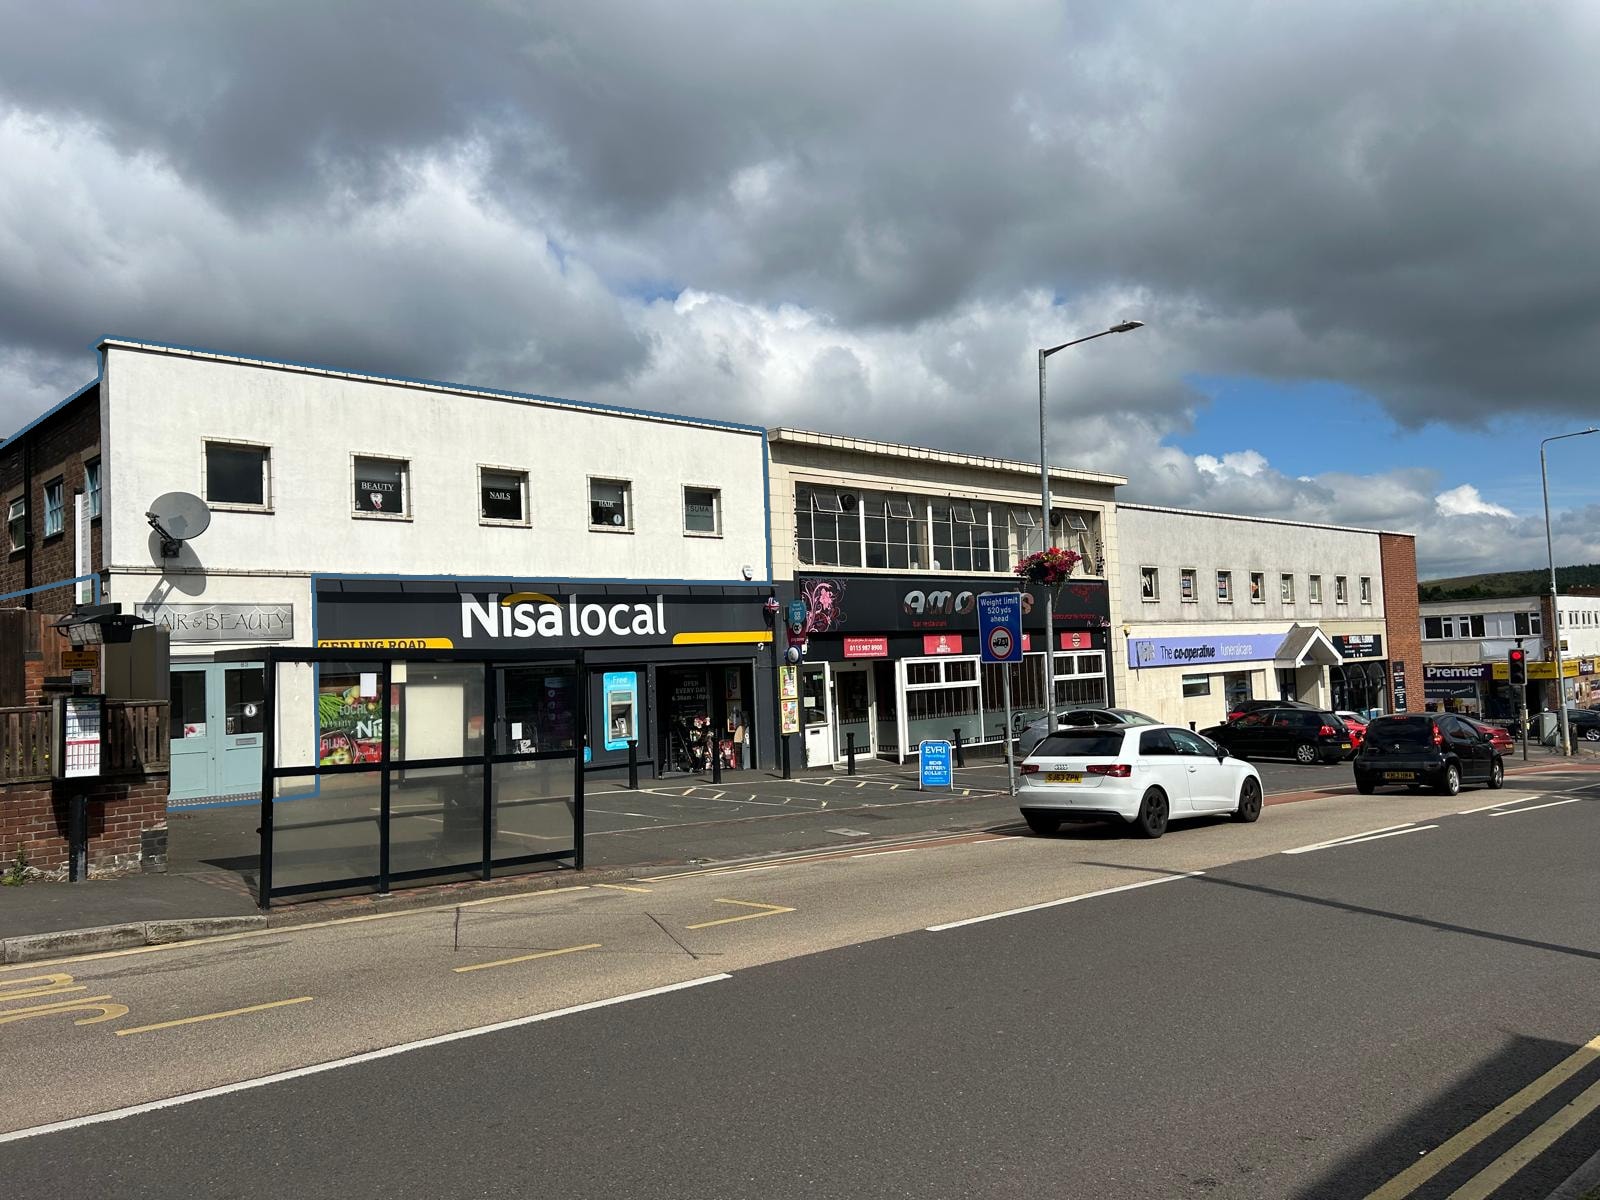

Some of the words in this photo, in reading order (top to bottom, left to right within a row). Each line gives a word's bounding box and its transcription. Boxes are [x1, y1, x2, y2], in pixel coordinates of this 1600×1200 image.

[361, 481, 394, 491] BEAUTY
[489, 491, 511, 500] NAILS
[980, 598, 1002, 606] Weight
[460, 592, 564, 638] Nisa
[569, 593, 667, 637] local
[987, 606, 1000, 614] 520
[1000, 607, 1011, 615] yds
[141, 613, 189, 630] HAIR
[192, 616, 203, 627] &
[206, 613, 288, 630] BEAUTY
[1160, 645, 1172, 660] The
[1173, 645, 1216, 661] co-operative
[1426, 667, 1485, 678] Premier
[612, 676, 628, 684] Free
[925, 746, 946, 754] EVRI
